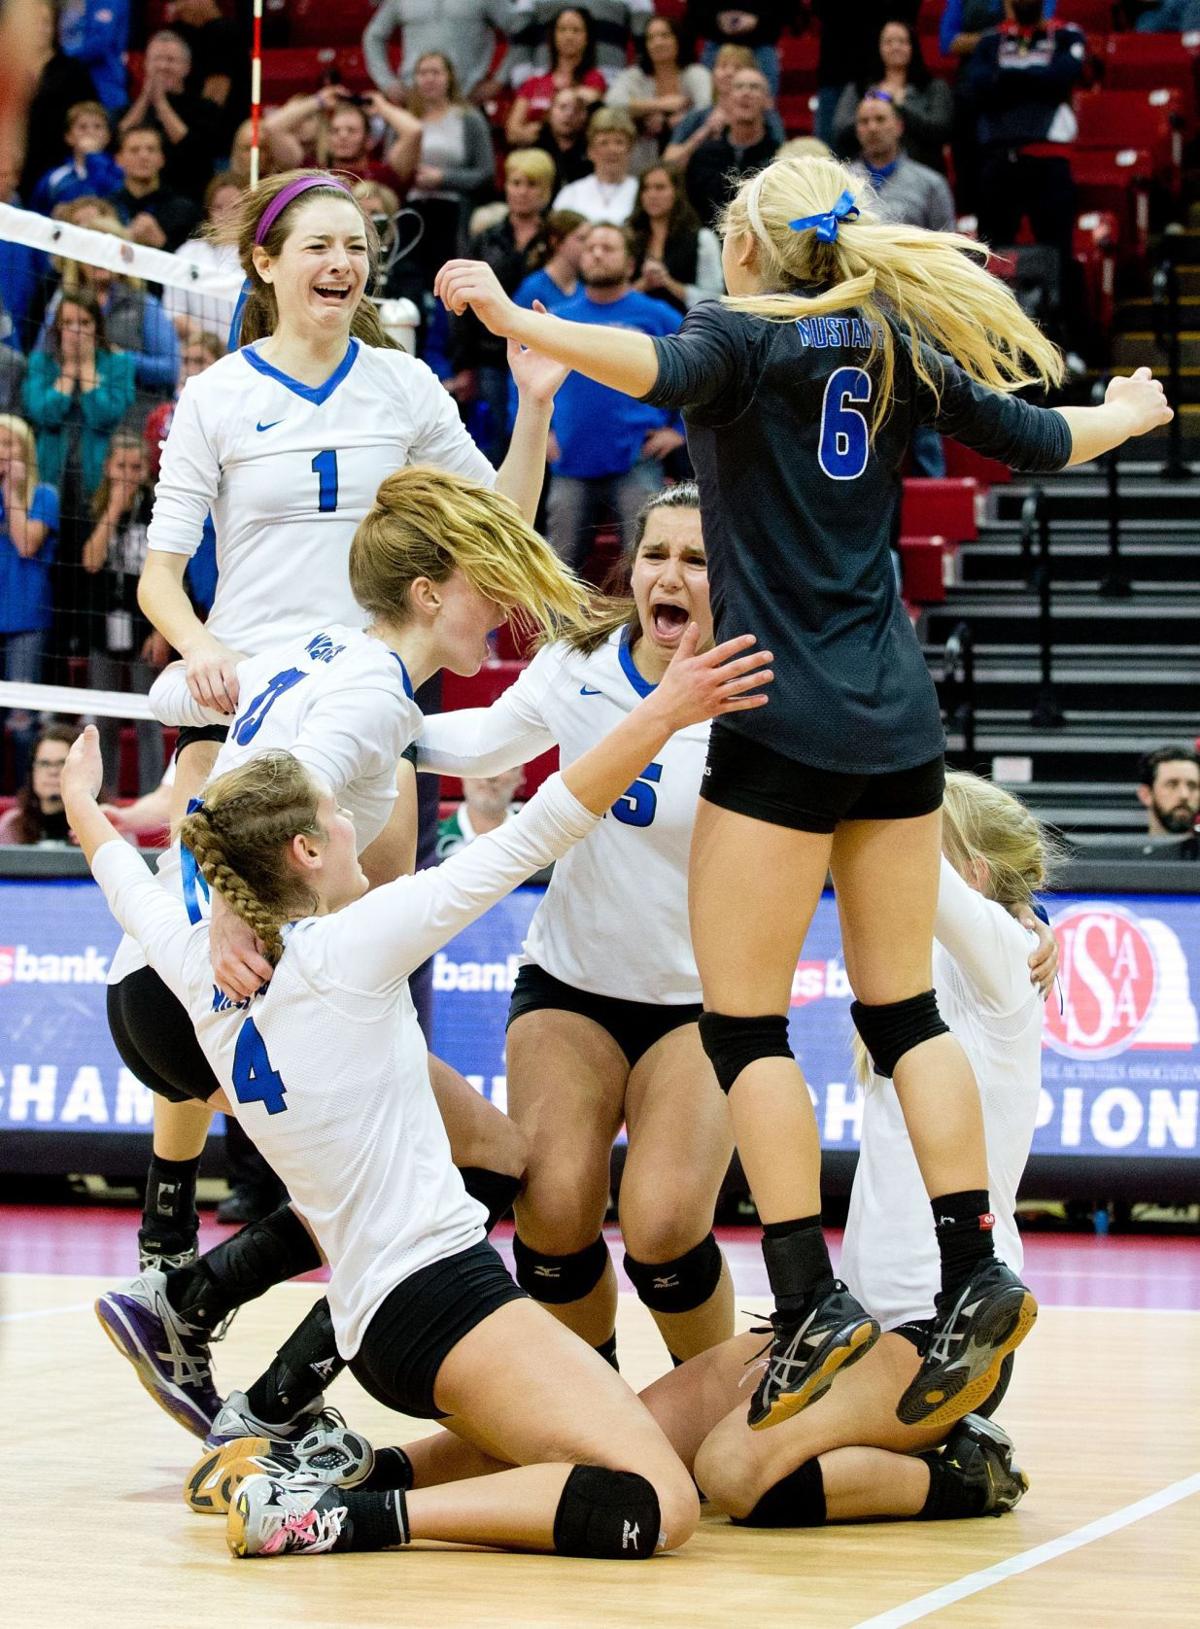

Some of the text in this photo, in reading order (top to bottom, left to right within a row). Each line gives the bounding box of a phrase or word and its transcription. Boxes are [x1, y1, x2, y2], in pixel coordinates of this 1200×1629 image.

[818, 366, 872, 480] 6
[311, 449, 338, 512] 1
[602, 762, 664, 828] 5
[232, 1016, 288, 1115] 4
